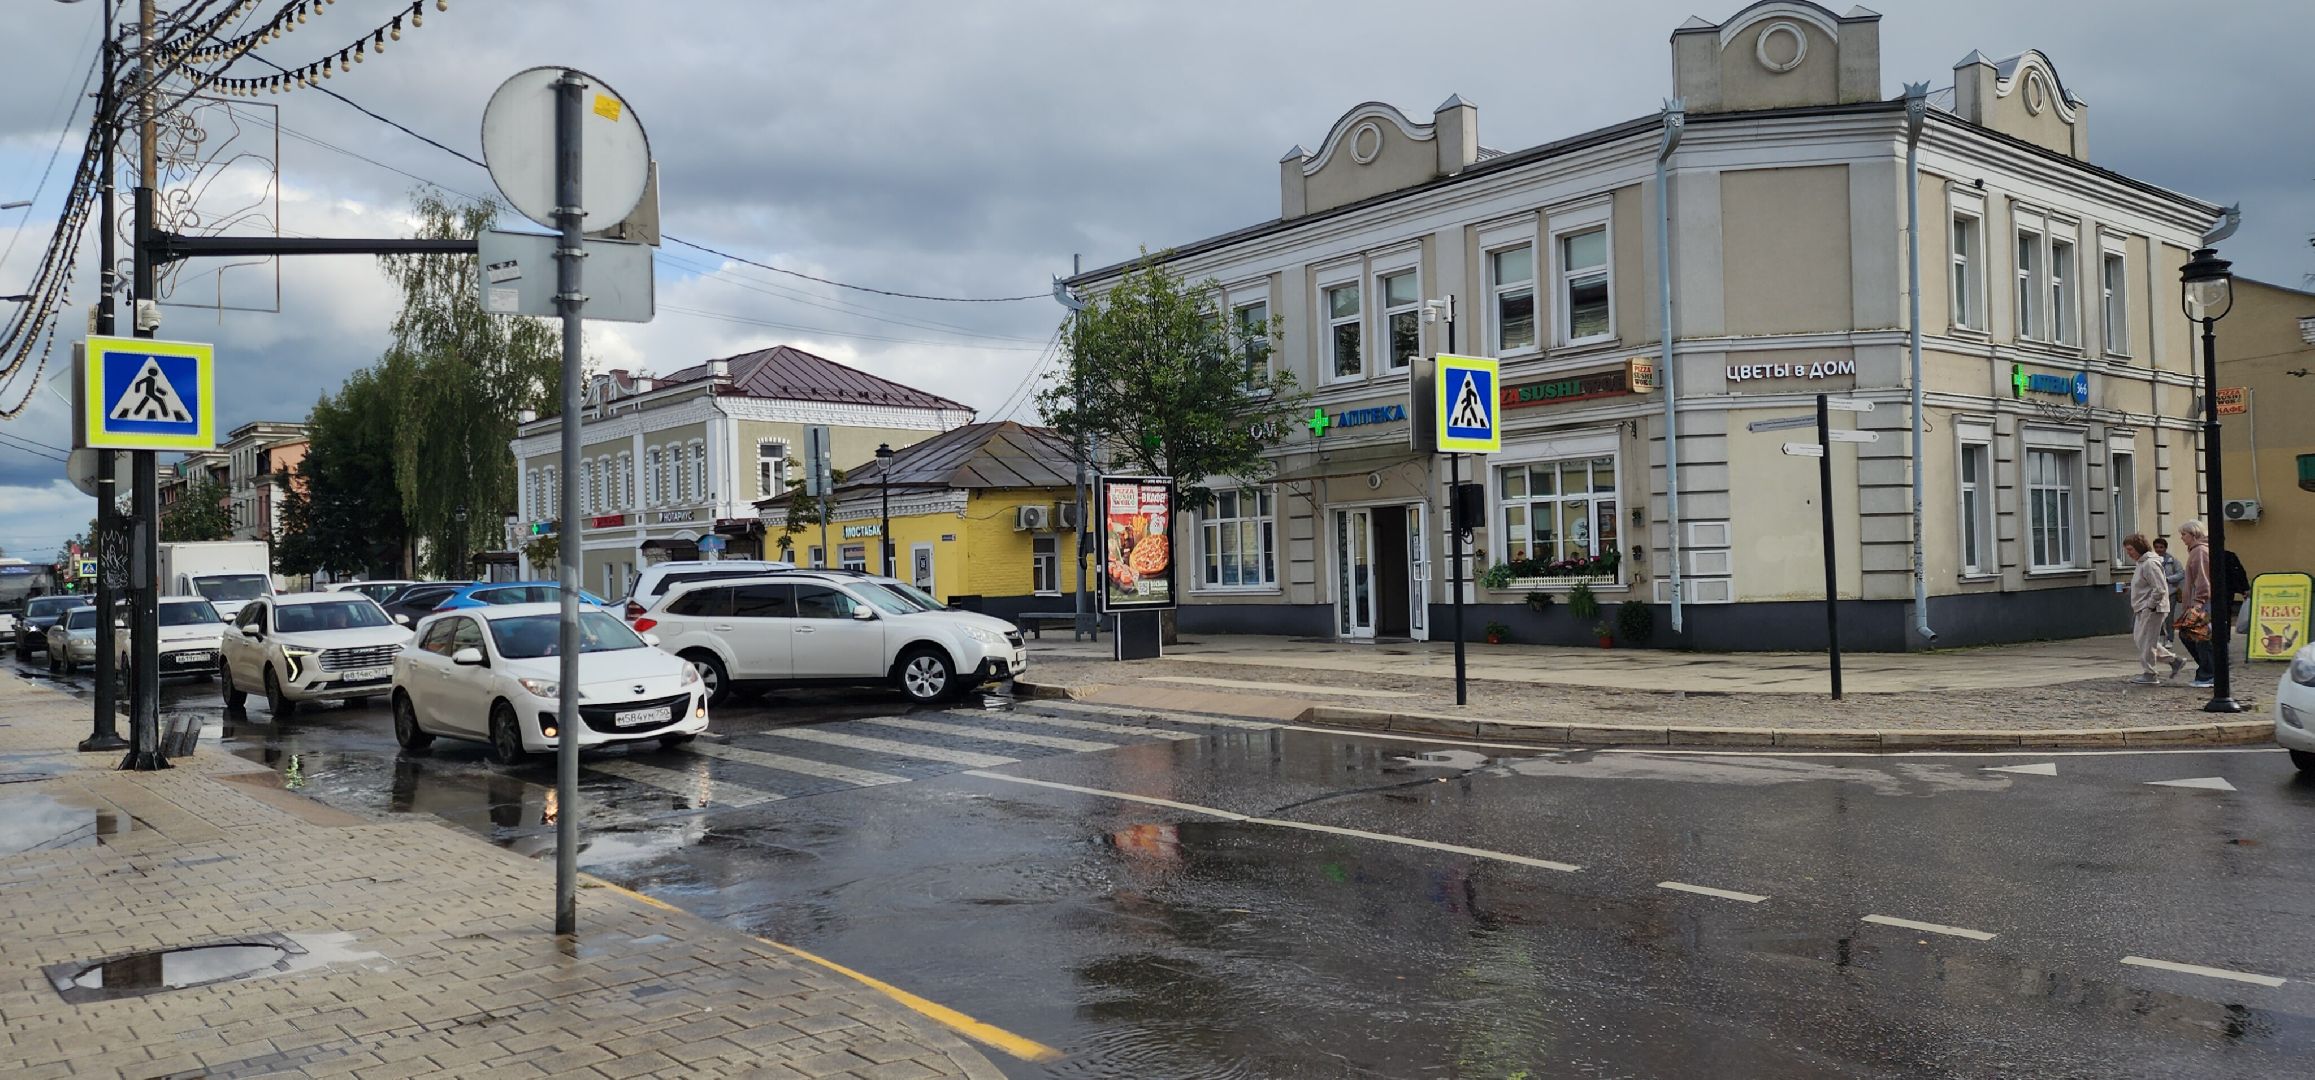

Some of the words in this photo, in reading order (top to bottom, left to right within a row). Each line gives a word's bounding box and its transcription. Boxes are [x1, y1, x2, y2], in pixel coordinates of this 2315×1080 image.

[1634, 365, 1651, 373] PIZZA
[1726, 363, 1790, 383] ЦВЕТЫ
[1794, 365, 1805, 377] в
[1808, 360, 1856, 379] ДОМ
[1518, 379, 1581, 402] SUSHI
[1337, 403, 1408, 429] АПТЕКА
[663, 511, 694, 522] НОТАРИУС
[2260, 605, 2302, 618] КВАС
